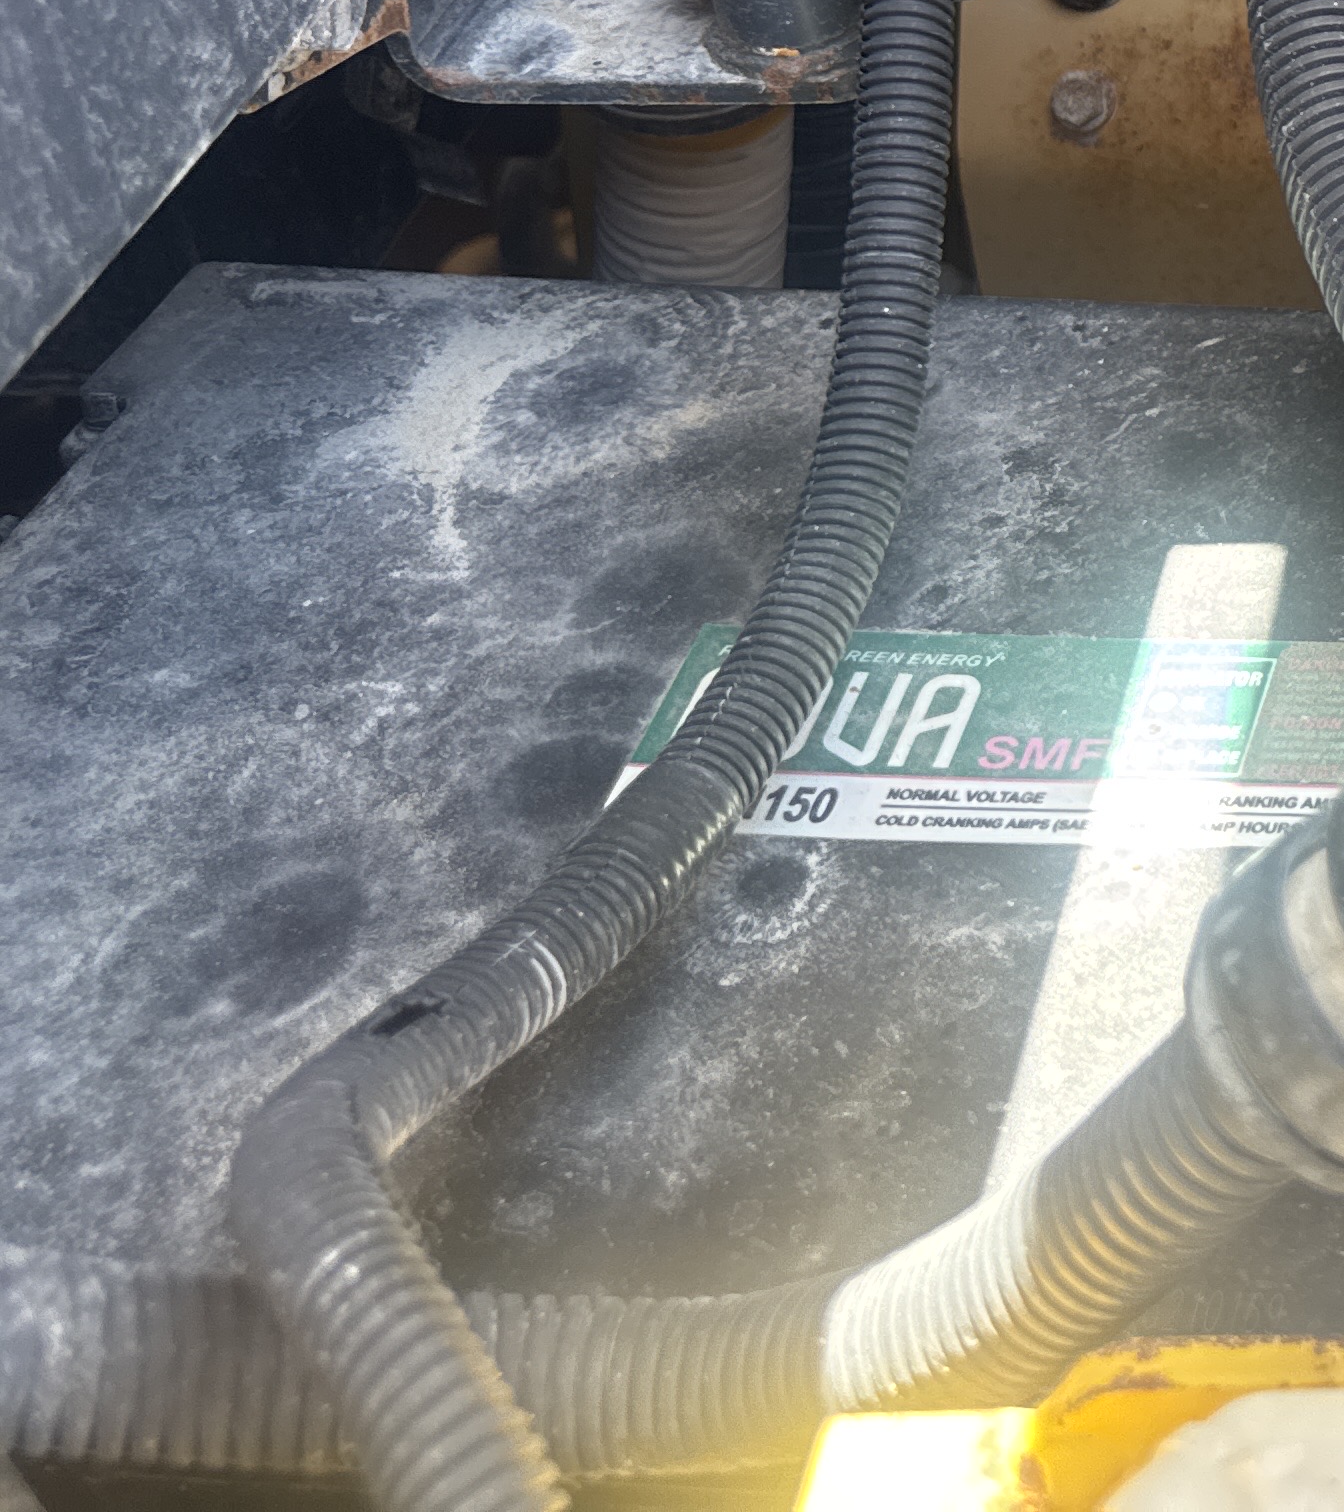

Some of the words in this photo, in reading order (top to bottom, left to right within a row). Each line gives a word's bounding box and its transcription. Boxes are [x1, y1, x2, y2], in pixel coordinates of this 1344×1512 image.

[843, 649, 905, 665] REEN
[907, 651, 1002, 668] ENERGY
[976, 735, 1113, 772] SMF
[886, 787, 962, 803] NORMAL
[965, 790, 1048, 804] VOLTAGE
[1218, 795, 1299, 809] RANKING
[874, 814, 919, 828] COLD
[921, 815, 1004, 830] CRANKING
[1004, 818, 1051, 831] AMPS
